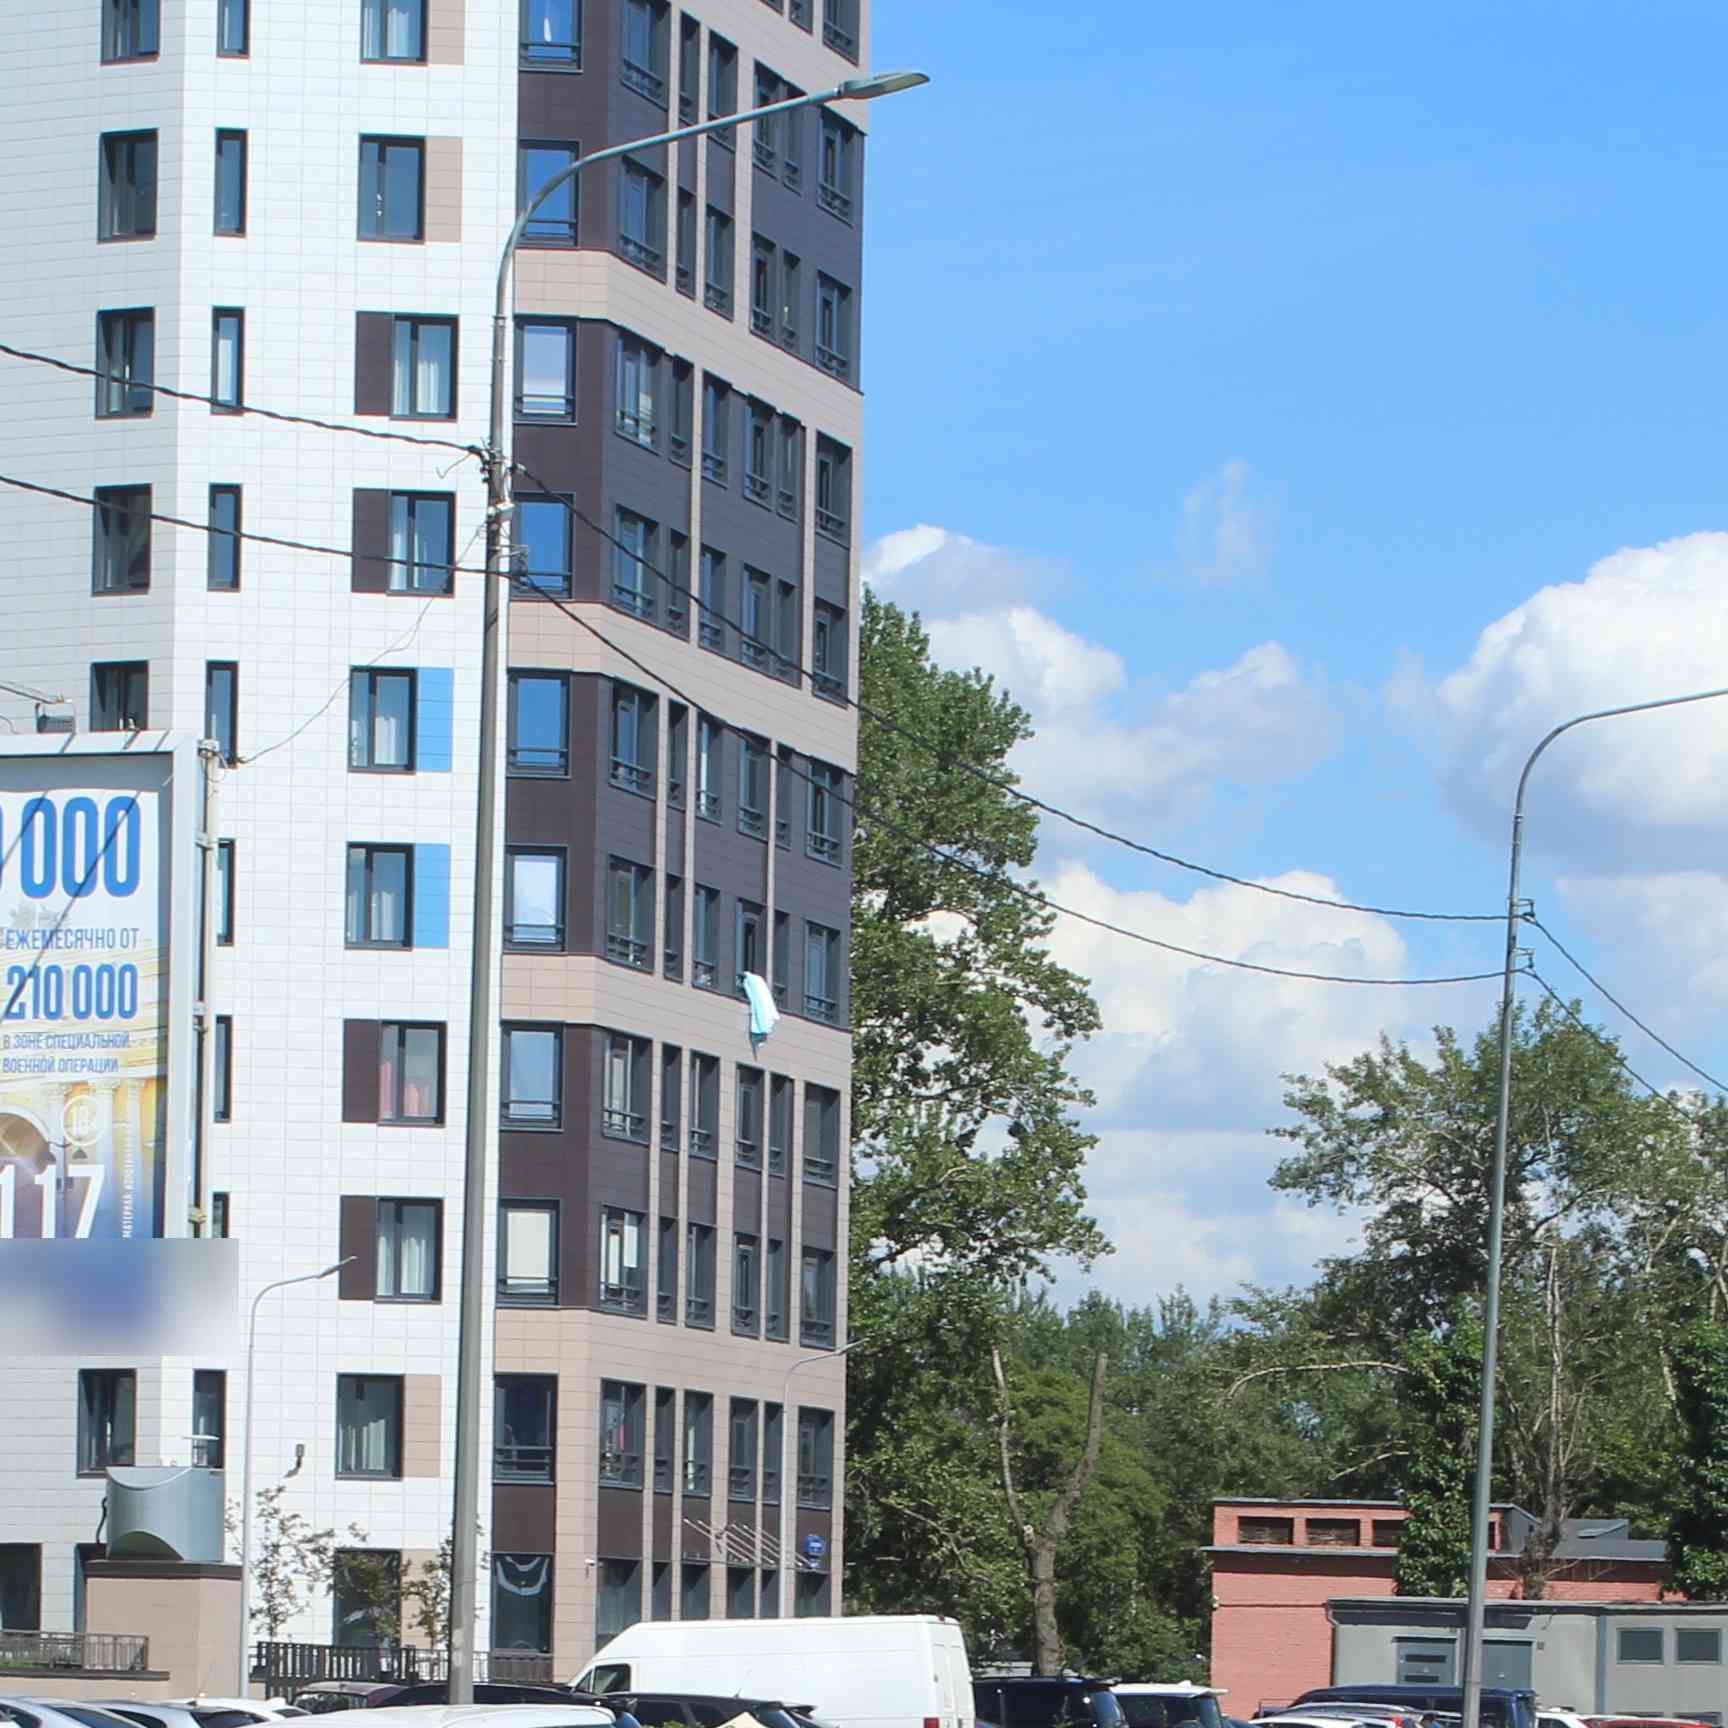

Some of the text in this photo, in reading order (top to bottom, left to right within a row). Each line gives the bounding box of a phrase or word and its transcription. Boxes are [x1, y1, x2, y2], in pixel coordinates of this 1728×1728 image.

[6, 928, 140, 950] ЕЖЕМЕСЯЧНО ОТ
[14, 1034, 44, 1049] ЗОНЕ
[46, 1031, 130, 1049] СПЕЦИАЛЬНОЙ
[2, 1057, 119, 1074] ВОЕННОЙ ОПЕРАЦИИ
